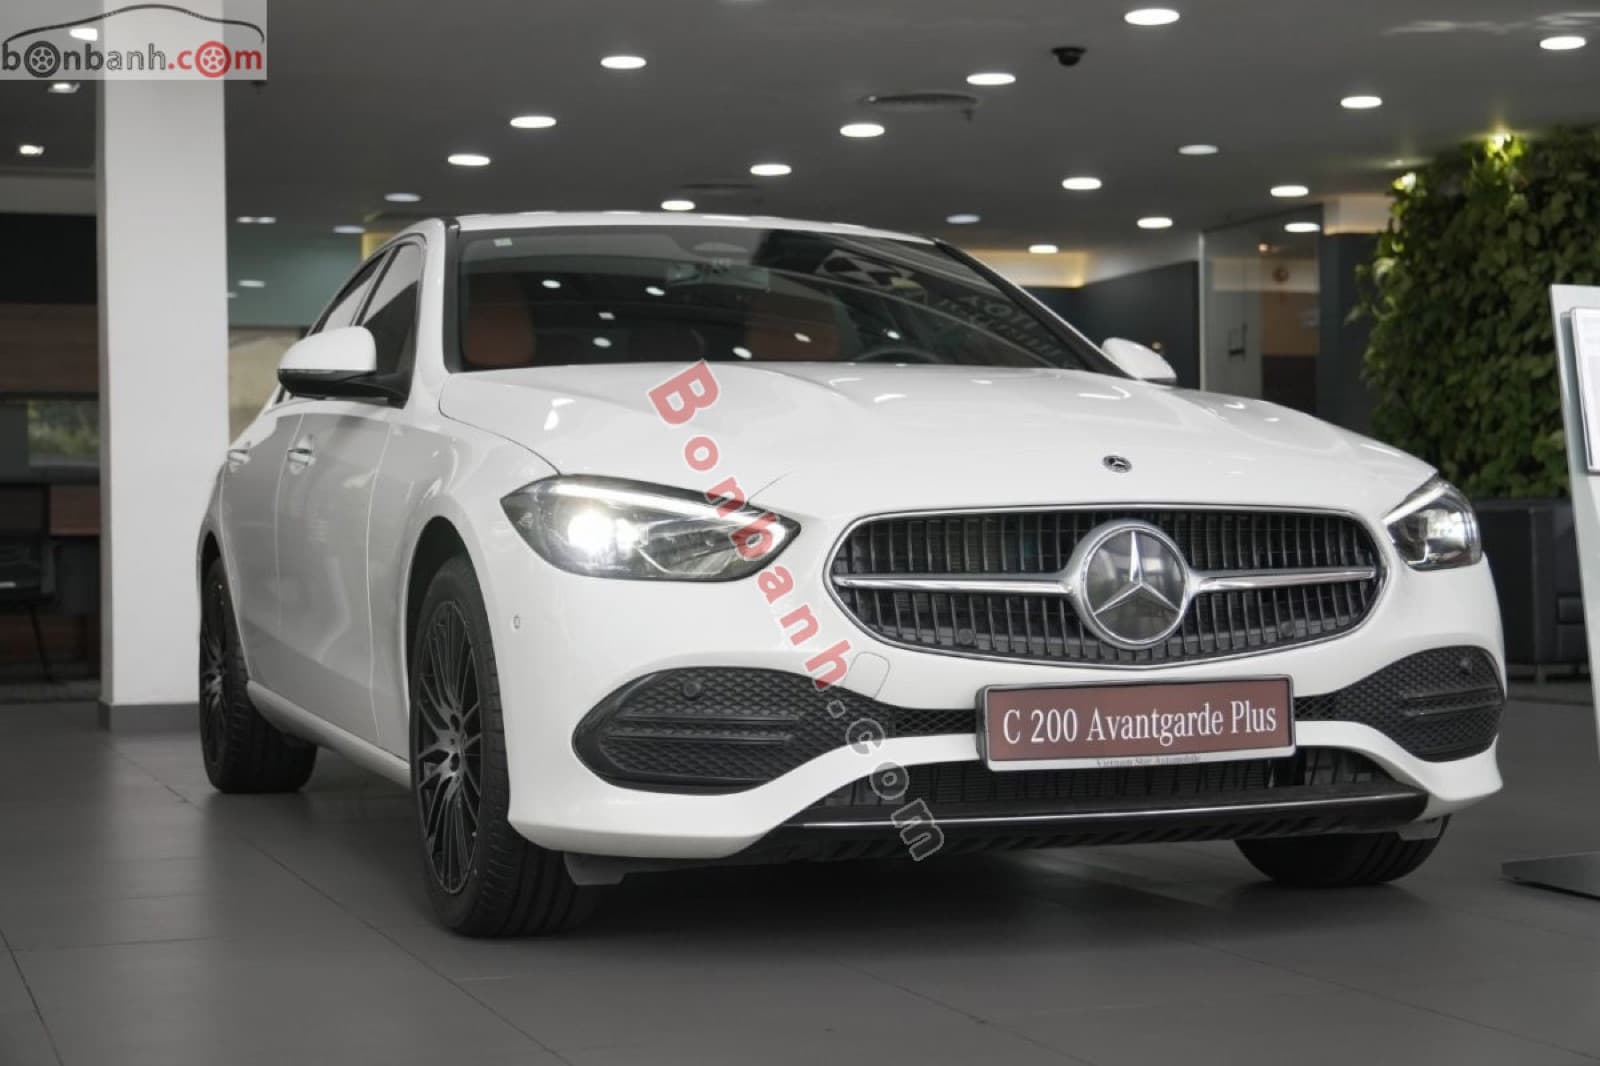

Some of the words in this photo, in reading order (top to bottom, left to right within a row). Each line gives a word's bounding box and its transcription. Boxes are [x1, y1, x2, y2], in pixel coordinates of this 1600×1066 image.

[1003, 709, 1021, 744] C
[1030, 708, 1078, 743] 200
[1086, 703, 1224, 747] Avantgarde
[1230, 700, 1277, 734] Plus
